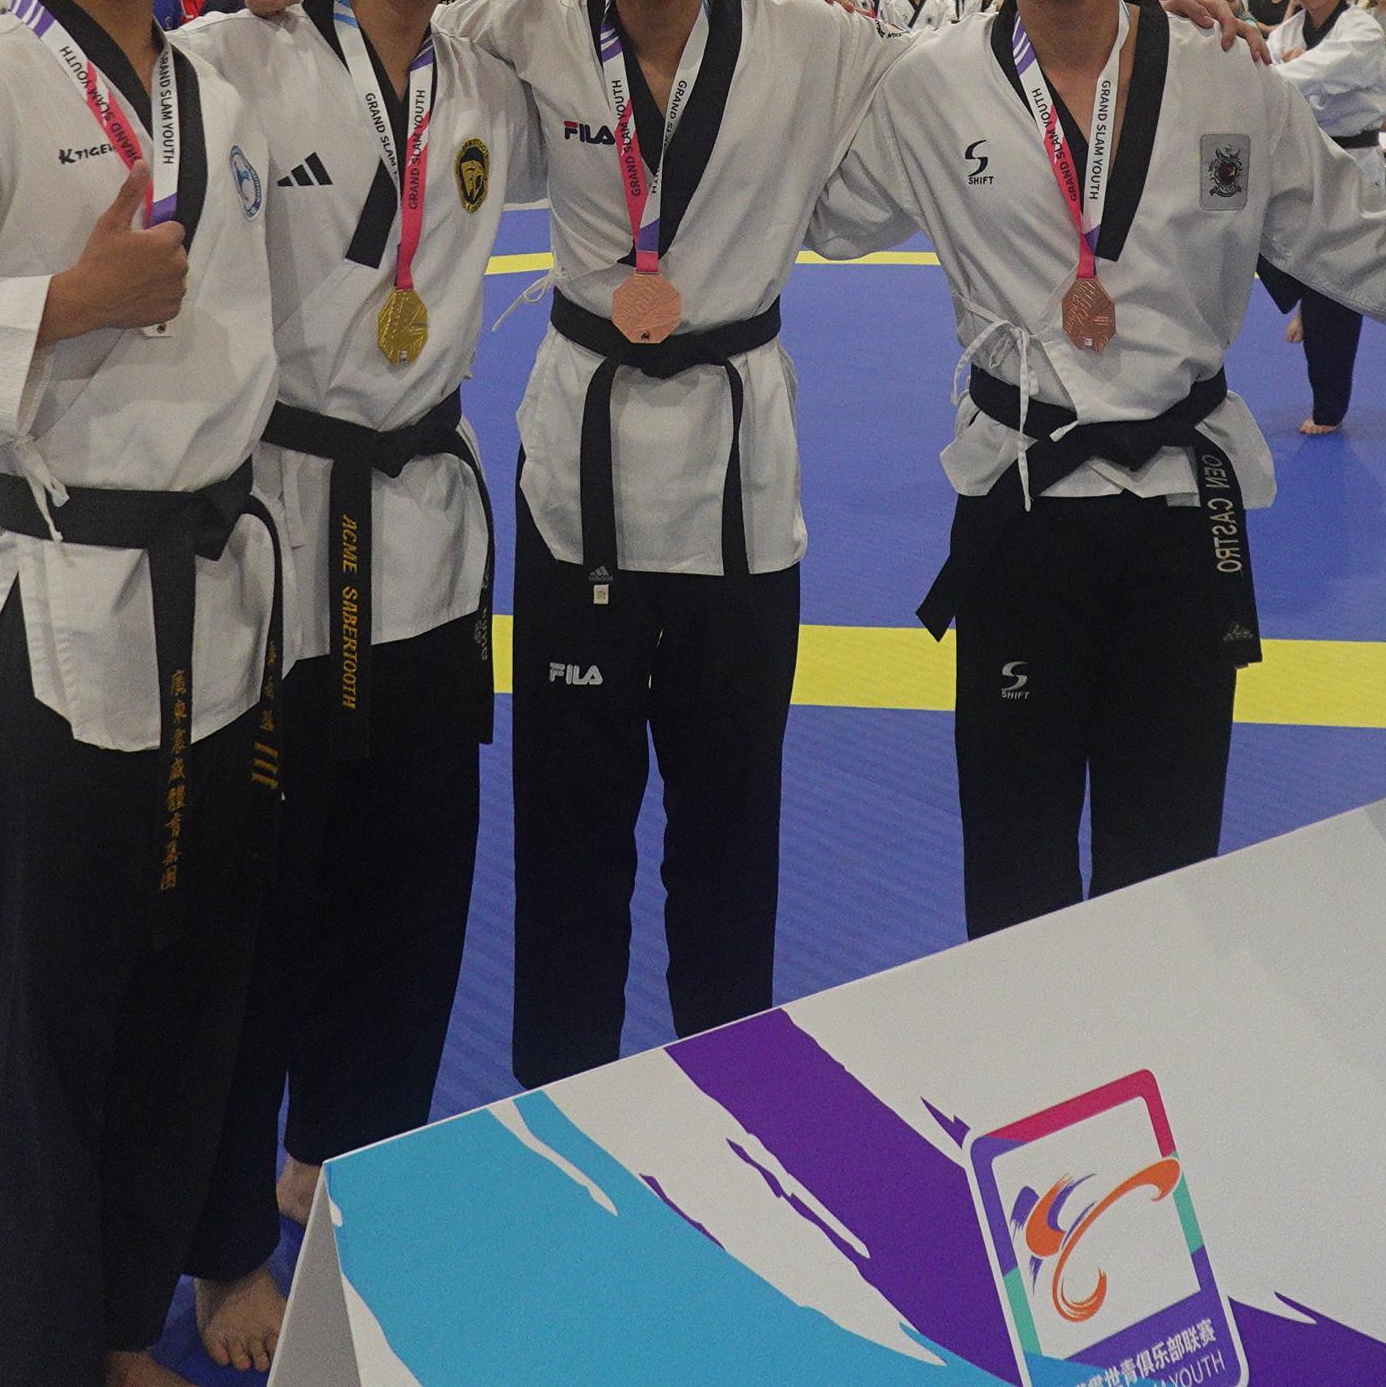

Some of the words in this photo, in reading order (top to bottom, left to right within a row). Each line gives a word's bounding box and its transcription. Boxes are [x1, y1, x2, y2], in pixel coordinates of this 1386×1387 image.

[59, 45, 92, 89] YOUTH
[87, 88, 116, 123] SLAM
[160, 89, 172, 121] SLAM
[413, 89, 426, 129] YOUTH
[611, 79, 627, 119] YOUTH
[668, 80, 687, 119] GRAND
[1031, 87, 1054, 128] YOUTH
[1096, 80, 1112, 121] GRAND
[162, 123, 175, 165] YOUTH
[365, 92, 386, 133] GRAND
[380, 135, 397, 167] SLAM
[411, 133, 423, 164] SLAM
[563, 120, 616, 146] FILA
[619, 121, 633, 154] SLAM
[1045, 129, 1063, 160] SLAM
[1093, 124, 1107, 156] SLAM
[409, 168, 421, 210] GRAND
[629, 156, 642, 197] GRAND
[968, 176, 995, 185] SHIFT
[1059, 160, 1078, 202] GRAND
[1088, 159, 1104, 200] YOUTH
[342, 513, 358, 574] ACME
[342, 585, 358, 710] SABERTOOTH
[549, 661, 604, 686] FILA
[1001, 691, 1031, 700] SHIFT
